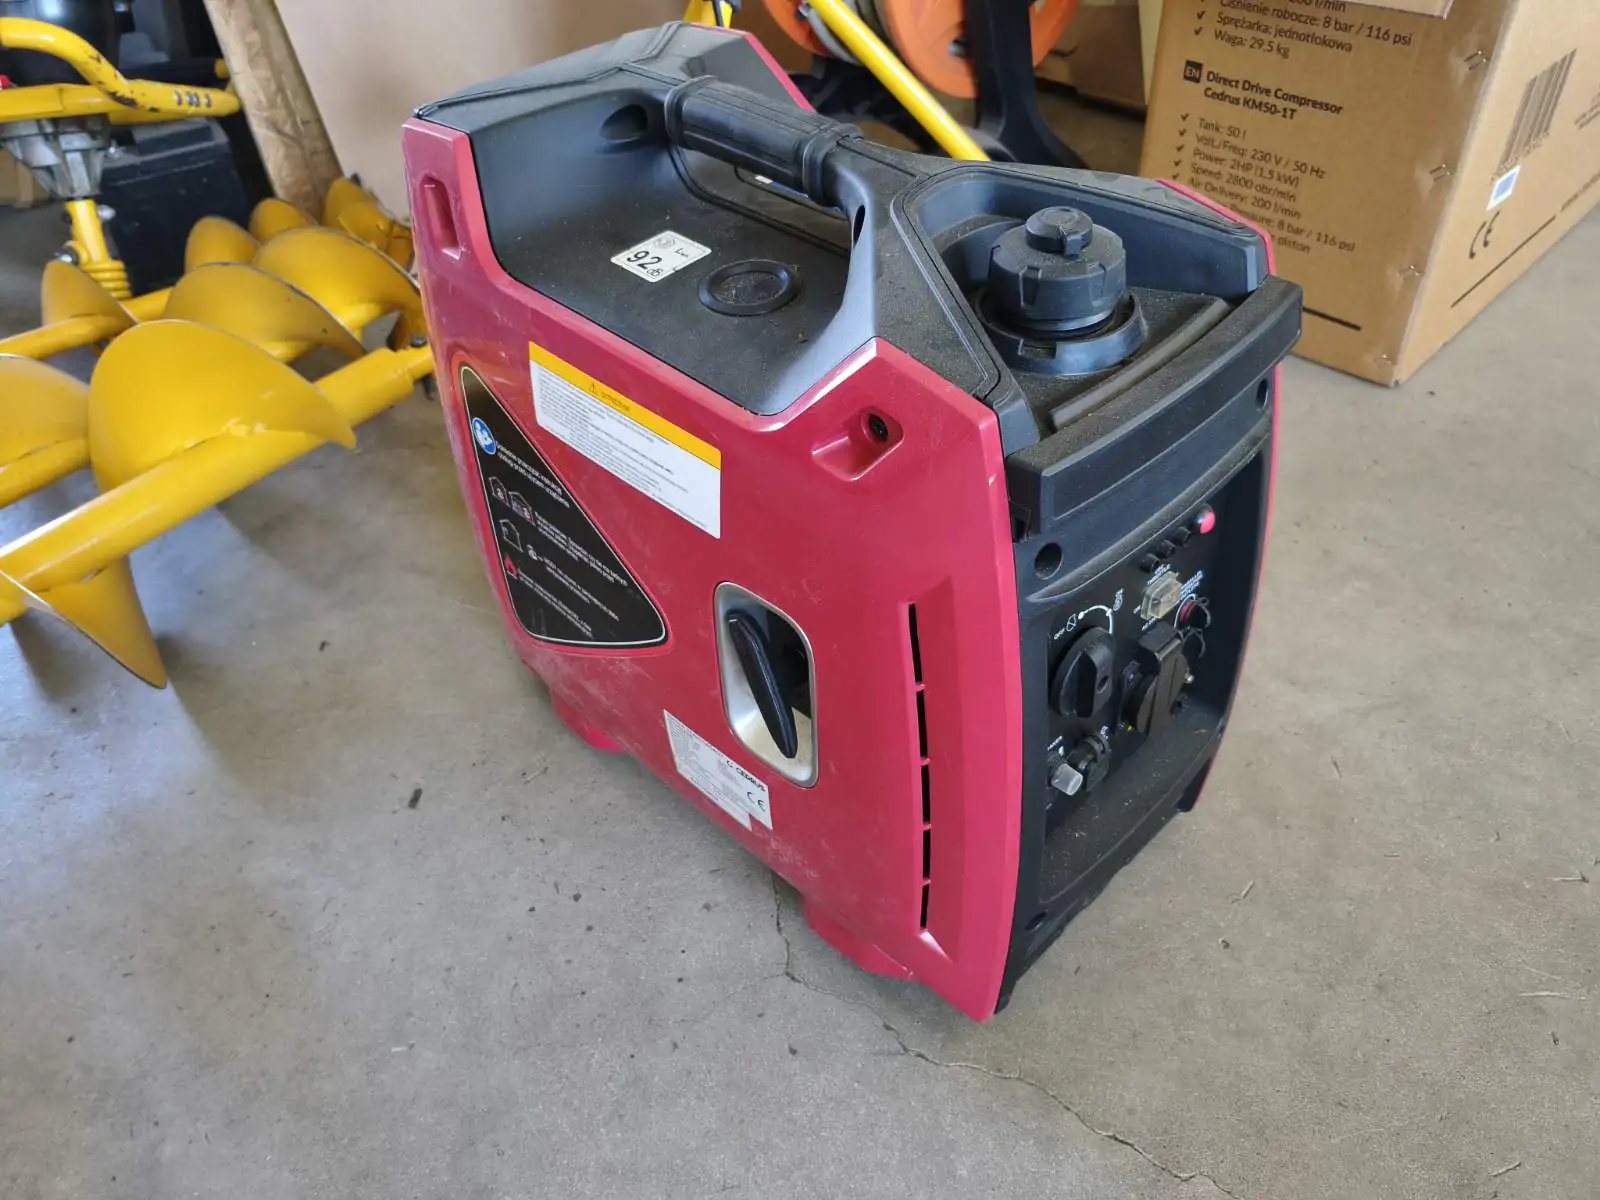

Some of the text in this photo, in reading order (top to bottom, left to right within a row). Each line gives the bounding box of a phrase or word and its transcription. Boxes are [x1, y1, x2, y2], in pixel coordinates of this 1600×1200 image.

[1271, 8, 1321, 27] robocze:
[1322, 15, 1332, 28] 8
[1333, 18, 1354, 33] bar
[1356, 22, 1364, 34] /
[1365, 25, 1391, 41] 116
[1392, 32, 1413, 46] psi
[1214, 29, 1290, 59] Waga: 29.5 kg
[1203, 87, 1298, 120] Cedrus KM50-1T
[1206, 70, 1344, 115] Direct Drive Compressor
[1199, 117, 1225, 133] Tank:
[1226, 125, 1241, 138] 50
[1192, 147, 1228, 166] Power:
[1229, 160, 1254, 173] 2HP
[1276, 170, 1300, 188] kW)
[1251, 149, 1272, 163] 230
[1273, 154, 1283, 166] V
[1292, 160, 1307, 174] 50
[1309, 165, 1328, 180] Hz
[1189, 177, 1203, 190] Air
[1204, 182, 1248, 204] Delivery:
[1251, 196, 1271, 210] 200
[1190, 163, 1297, 202] Speed: 2800 obr/min
[1277, 219, 1285, 231] 8
[1287, 222, 1306, 236] bar
[1316, 231, 1337, 246] 116
[1338, 239, 1357, 252] psi
[1277, 236, 1312, 255] piston
[627, 250, 662, 270] 92
